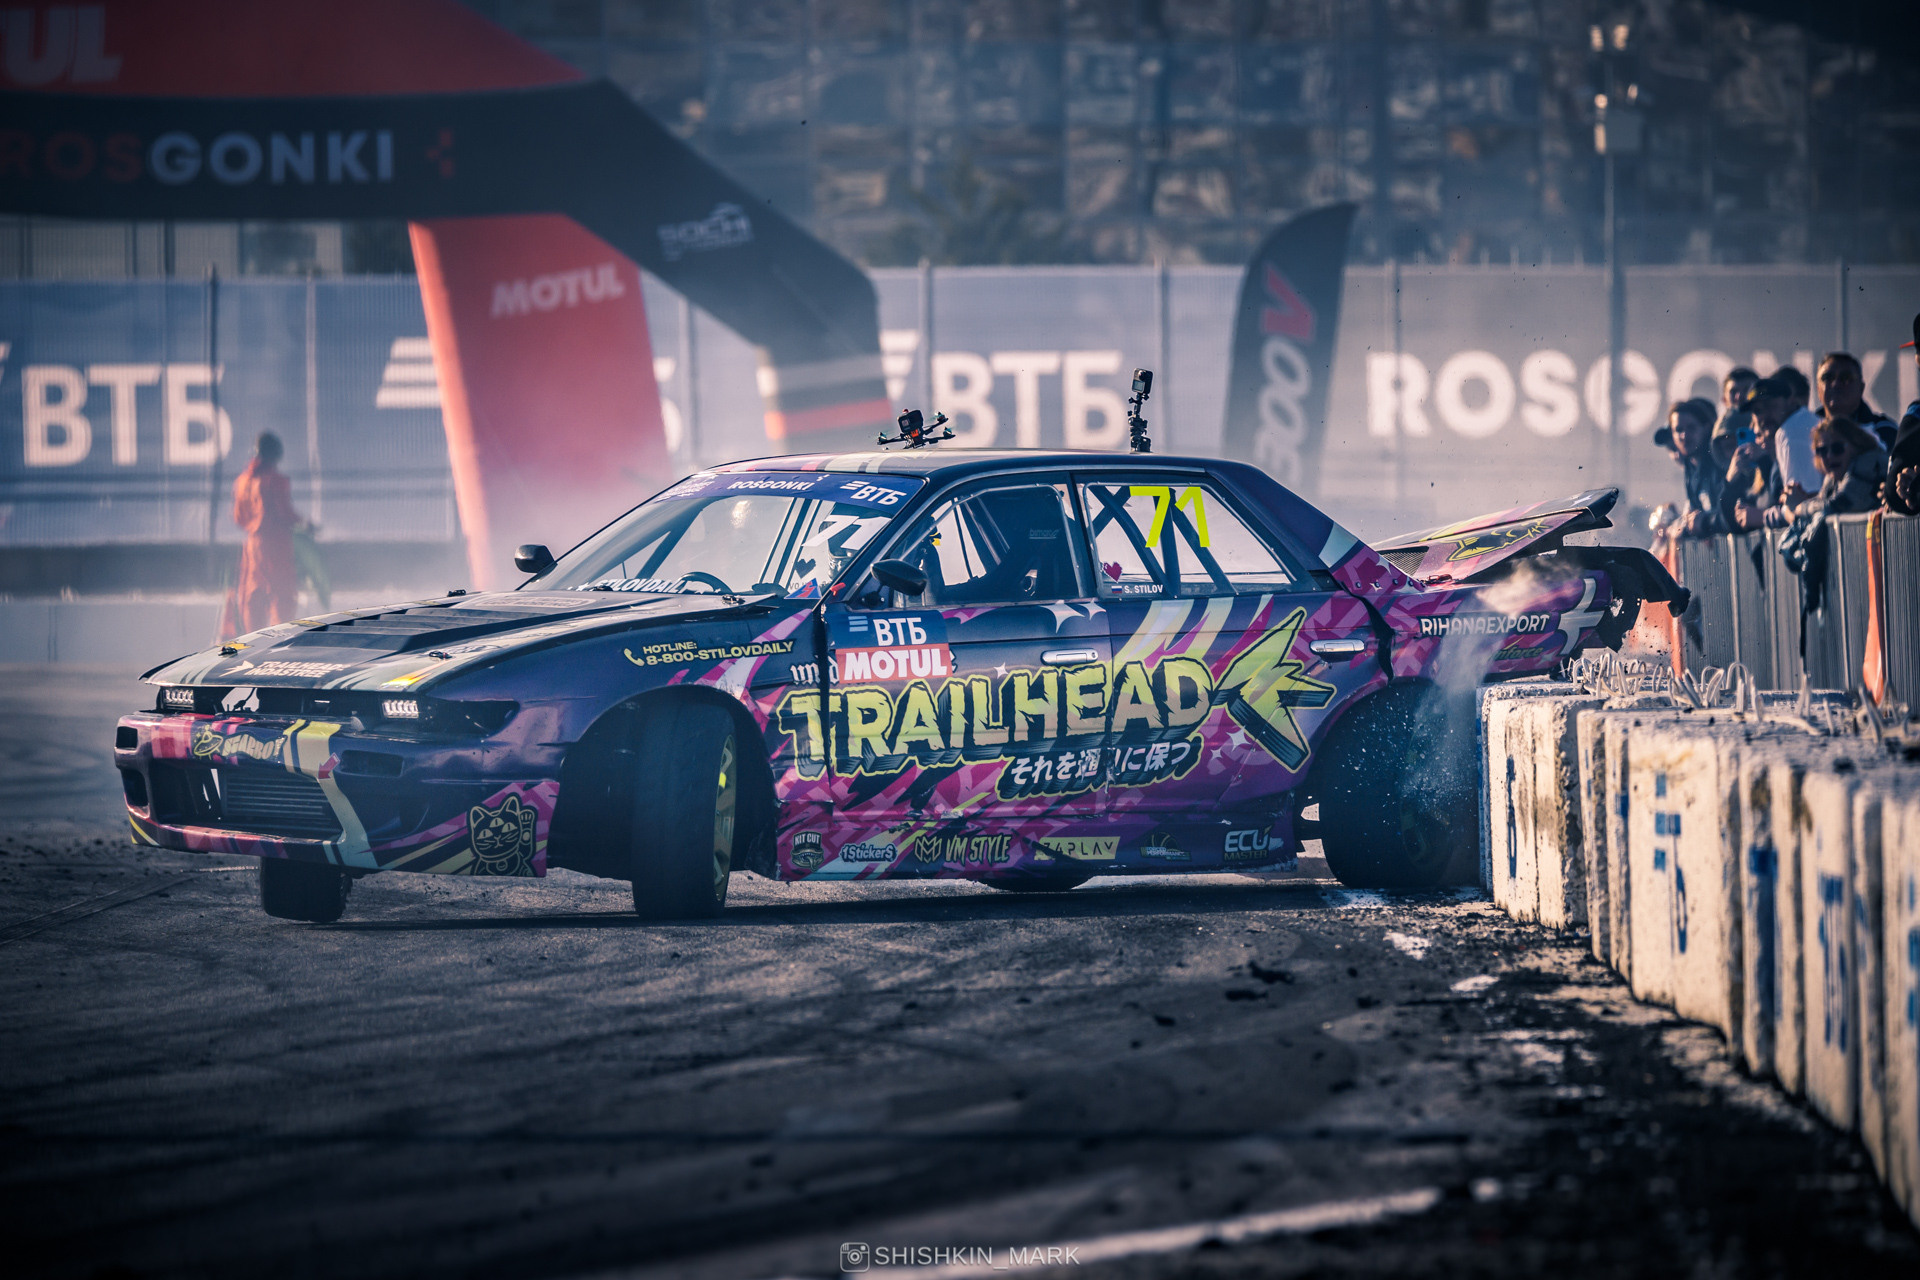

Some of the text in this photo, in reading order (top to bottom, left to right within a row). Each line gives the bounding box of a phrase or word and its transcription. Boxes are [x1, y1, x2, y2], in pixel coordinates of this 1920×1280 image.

[0, 7, 123, 83] UL
[491, 264, 625, 318] MOTUL
[22, 363, 233, 467] ВТБ
[931, 350, 1126, 450] ВТБ
[727, 479, 815, 491] ROSGONKI
[850, 484, 907, 506] ВТБ
[801, 514, 892, 550] 71
[1129, 486, 1211, 548] 71
[1124, 584, 1163, 594] S. STILOV
[873, 616, 927, 647] ВТБ
[1420, 614, 1550, 636] RIHANAEXPORT
[642, 641, 698, 655] HOTLINE:
[646, 641, 794, 666] 8-800-STILOVDAILY
[844, 648, 948, 681] MOTUL
[784, 656, 1213, 770] TRAILHEAD
[795, 832, 820, 846] KIT CUT
[945, 833, 1012, 866] VM STYLE
[1225, 826, 1271, 852] ECU
[1224, 849, 1268, 861] MASTER
